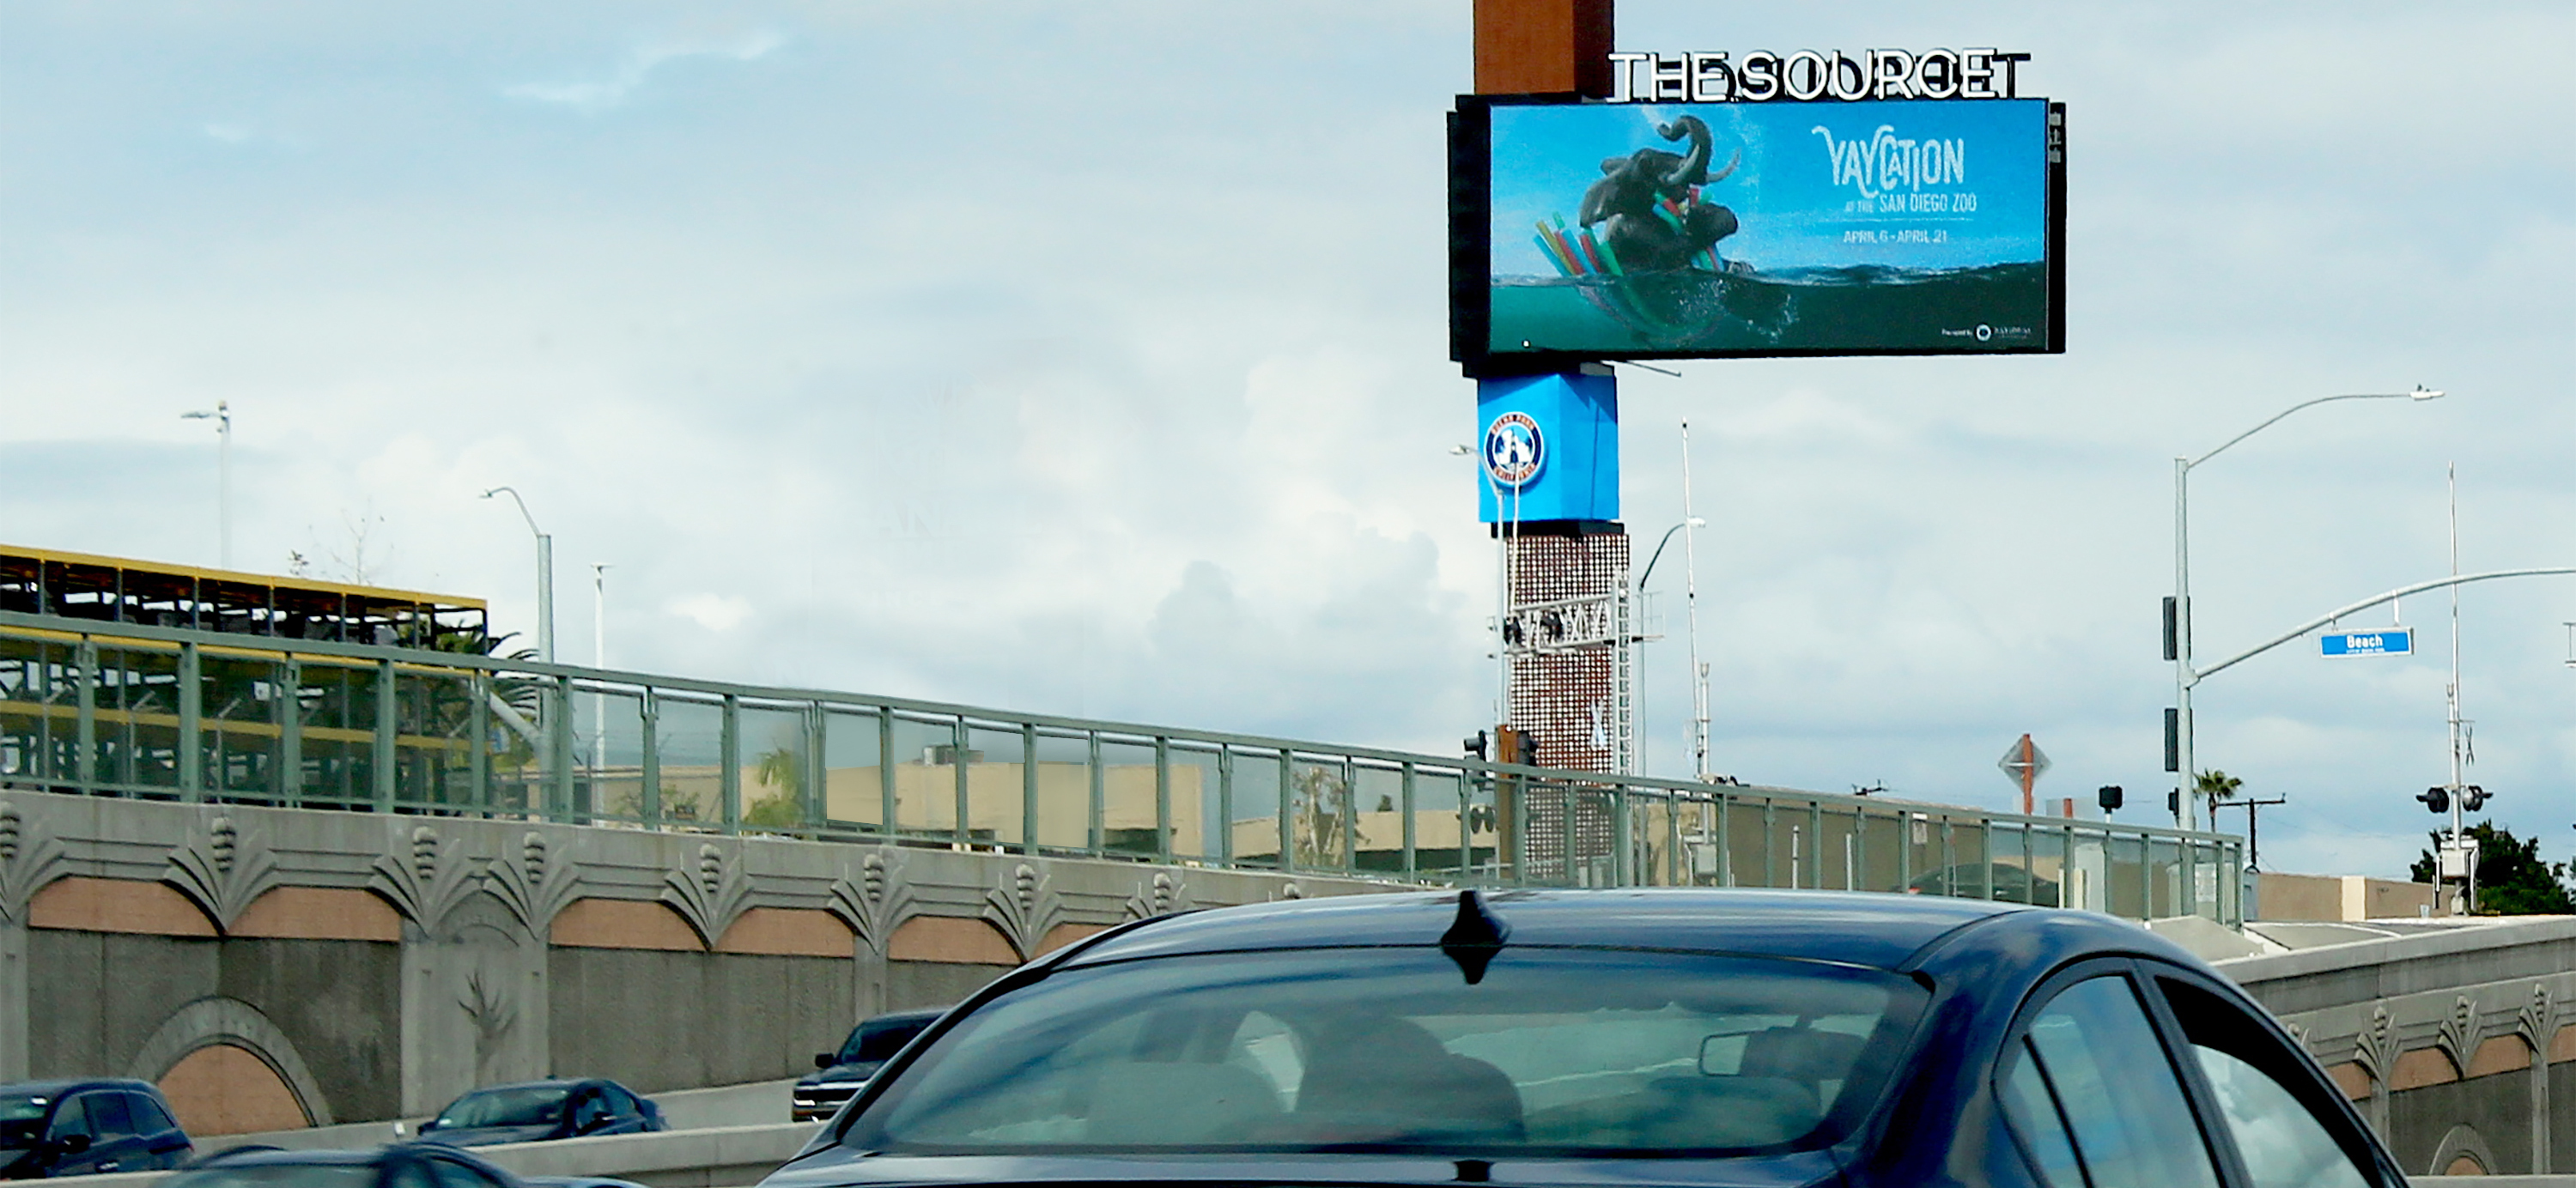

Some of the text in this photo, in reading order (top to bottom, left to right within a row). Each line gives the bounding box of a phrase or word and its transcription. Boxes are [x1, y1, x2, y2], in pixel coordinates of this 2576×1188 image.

[1608, 48, 1997, 102] THE SOURCE
[1811, 124, 1965, 198] YAYCATION
[1880, 194, 1905, 213] SAN
[1910, 193, 1947, 212] DIEGO
[1953, 192, 1977, 212] ZOO
[1843, 230, 1877, 243] APRIL
[1896, 230, 1928, 243] APRIL
[1933, 230, 1947, 243] 21
[2347, 633, 2383, 648] Beach
